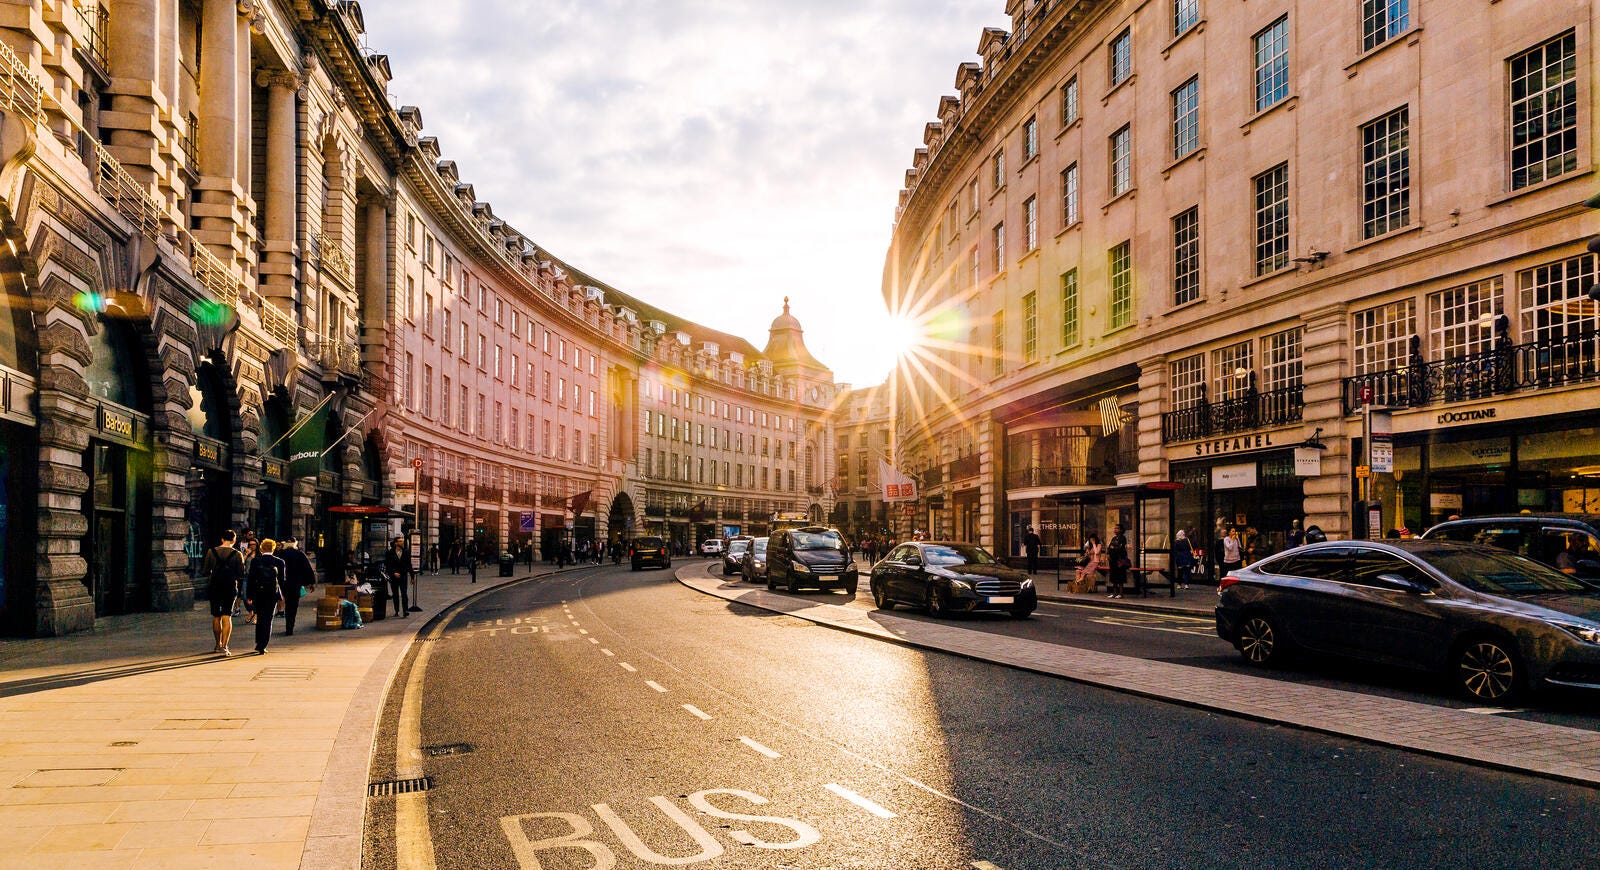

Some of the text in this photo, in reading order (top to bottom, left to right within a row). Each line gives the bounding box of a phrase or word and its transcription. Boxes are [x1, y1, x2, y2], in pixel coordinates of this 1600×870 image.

[1363, 388, 1370, 399] F
[105, 411, 132, 435] Barbour
[1437, 408, 1496, 424] L'OCCITANE
[1195, 434, 1272, 455] STEFANEL
[290, 450, 319, 462] arbour
[500, 789, 820, 870] BUS
